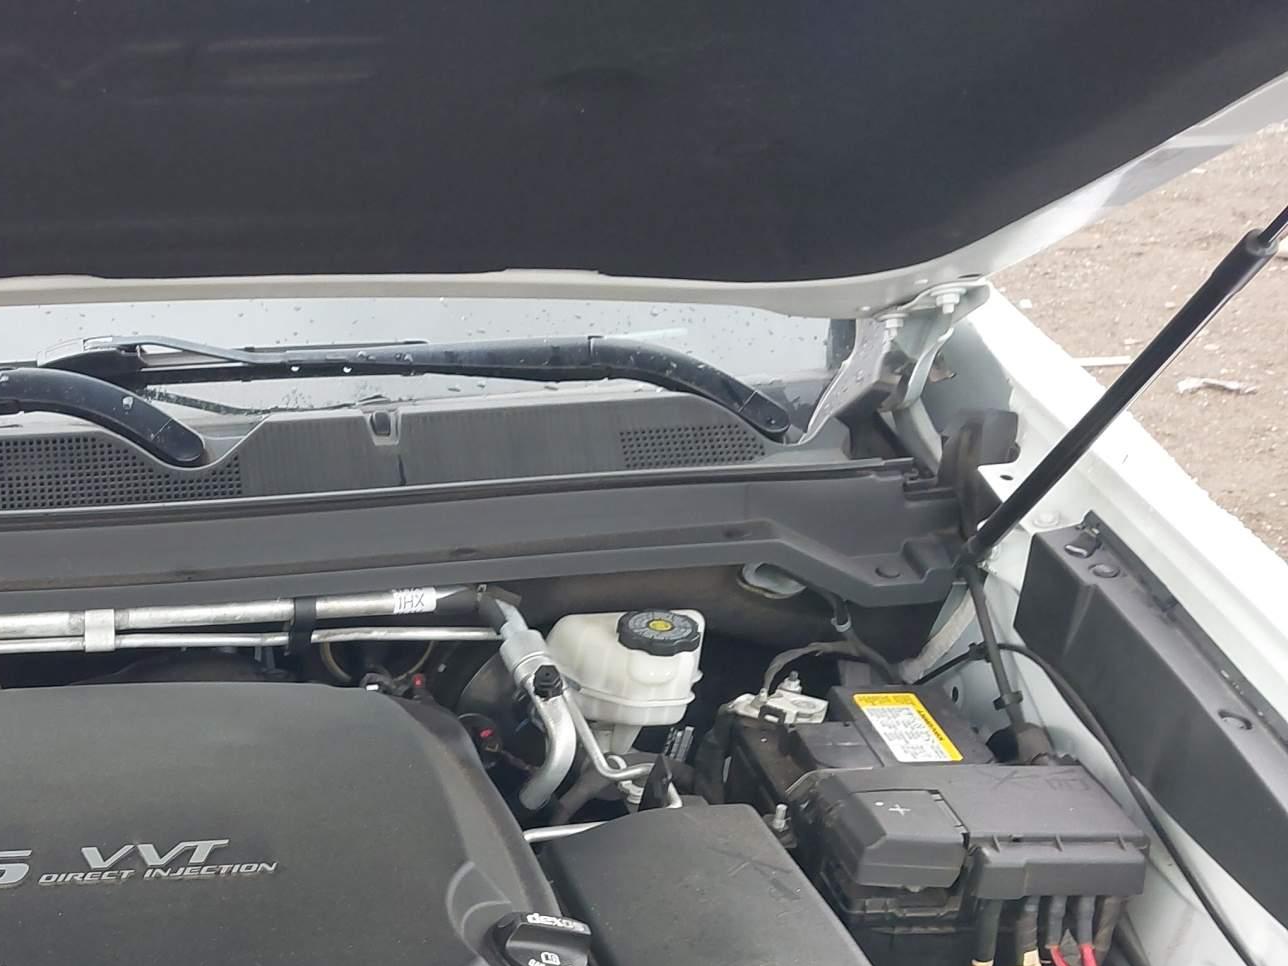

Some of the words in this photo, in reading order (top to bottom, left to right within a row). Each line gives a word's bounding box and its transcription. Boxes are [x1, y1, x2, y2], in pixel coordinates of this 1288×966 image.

[80, 839, 230, 869] VVT
[38, 869, 136, 884] DIRECT
[143, 862, 278, 878] INJECTION
